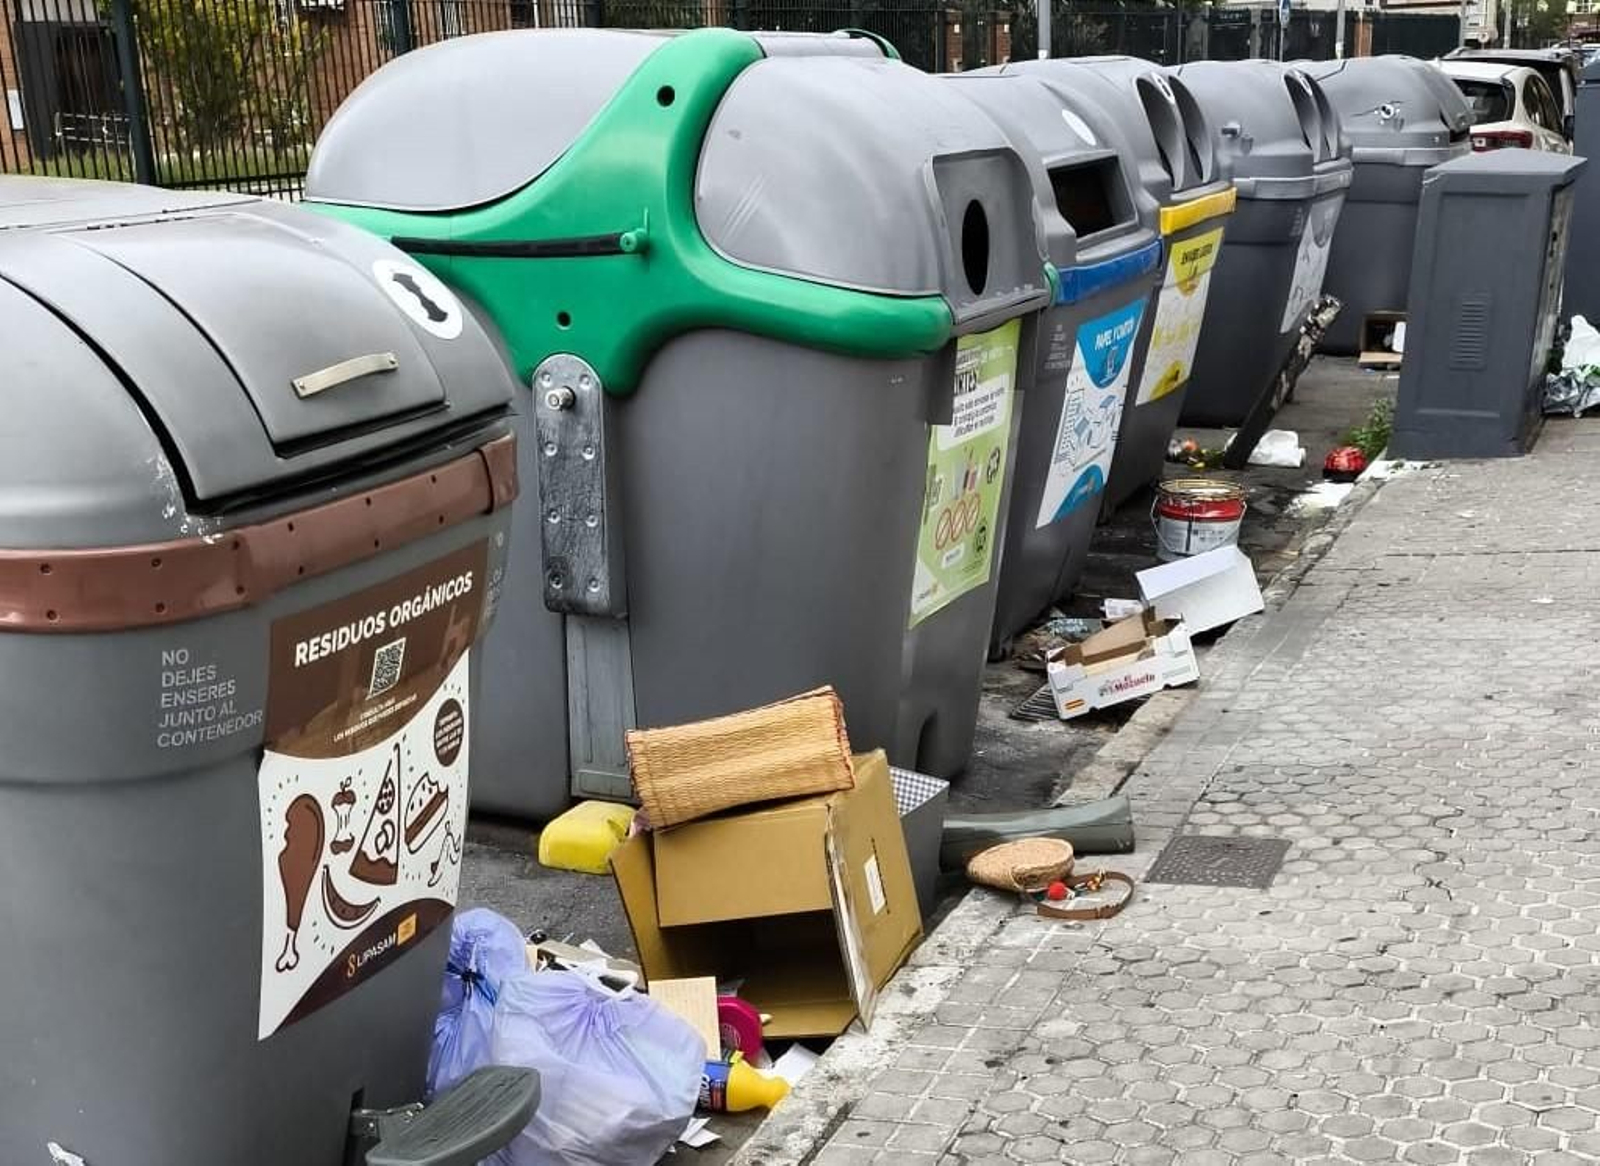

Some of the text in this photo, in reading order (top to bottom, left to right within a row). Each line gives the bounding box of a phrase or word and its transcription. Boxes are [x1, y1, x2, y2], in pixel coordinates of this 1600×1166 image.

[294, 611, 386, 668] RESIDUOS
[389, 571, 473, 628] ORGÁNICOS
[161, 648, 190, 666] NO
[161, 664, 217, 688] DEJES
[161, 679, 236, 708] ENSERES
[159, 699, 237, 728] JUNTO AL
[157, 709, 263, 748] CONTENEDOR
[356, 932, 397, 968] LIPASAM
